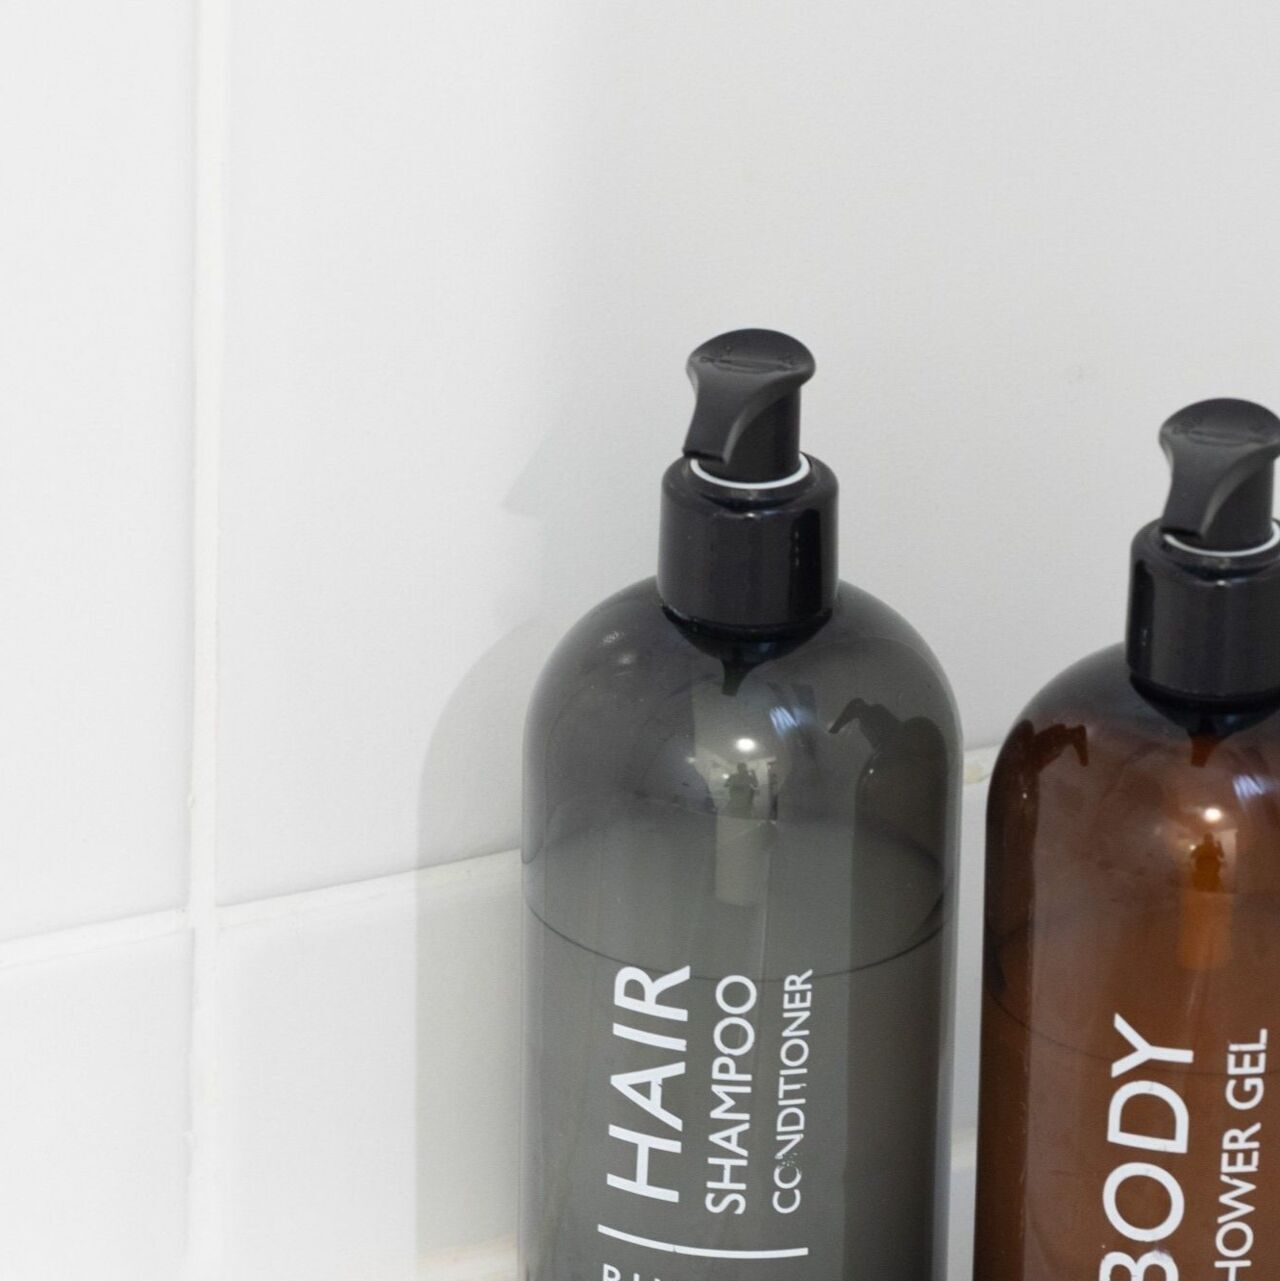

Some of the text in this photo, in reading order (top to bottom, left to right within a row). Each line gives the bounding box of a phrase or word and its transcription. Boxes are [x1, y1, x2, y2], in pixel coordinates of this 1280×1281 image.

[606, 965, 691, 1203] HAIR
[704, 974, 758, 1215] SHAMPOO
[772, 969, 813, 1214] CONDITIONER
[1225, 1028, 1268, 1110] GEL
